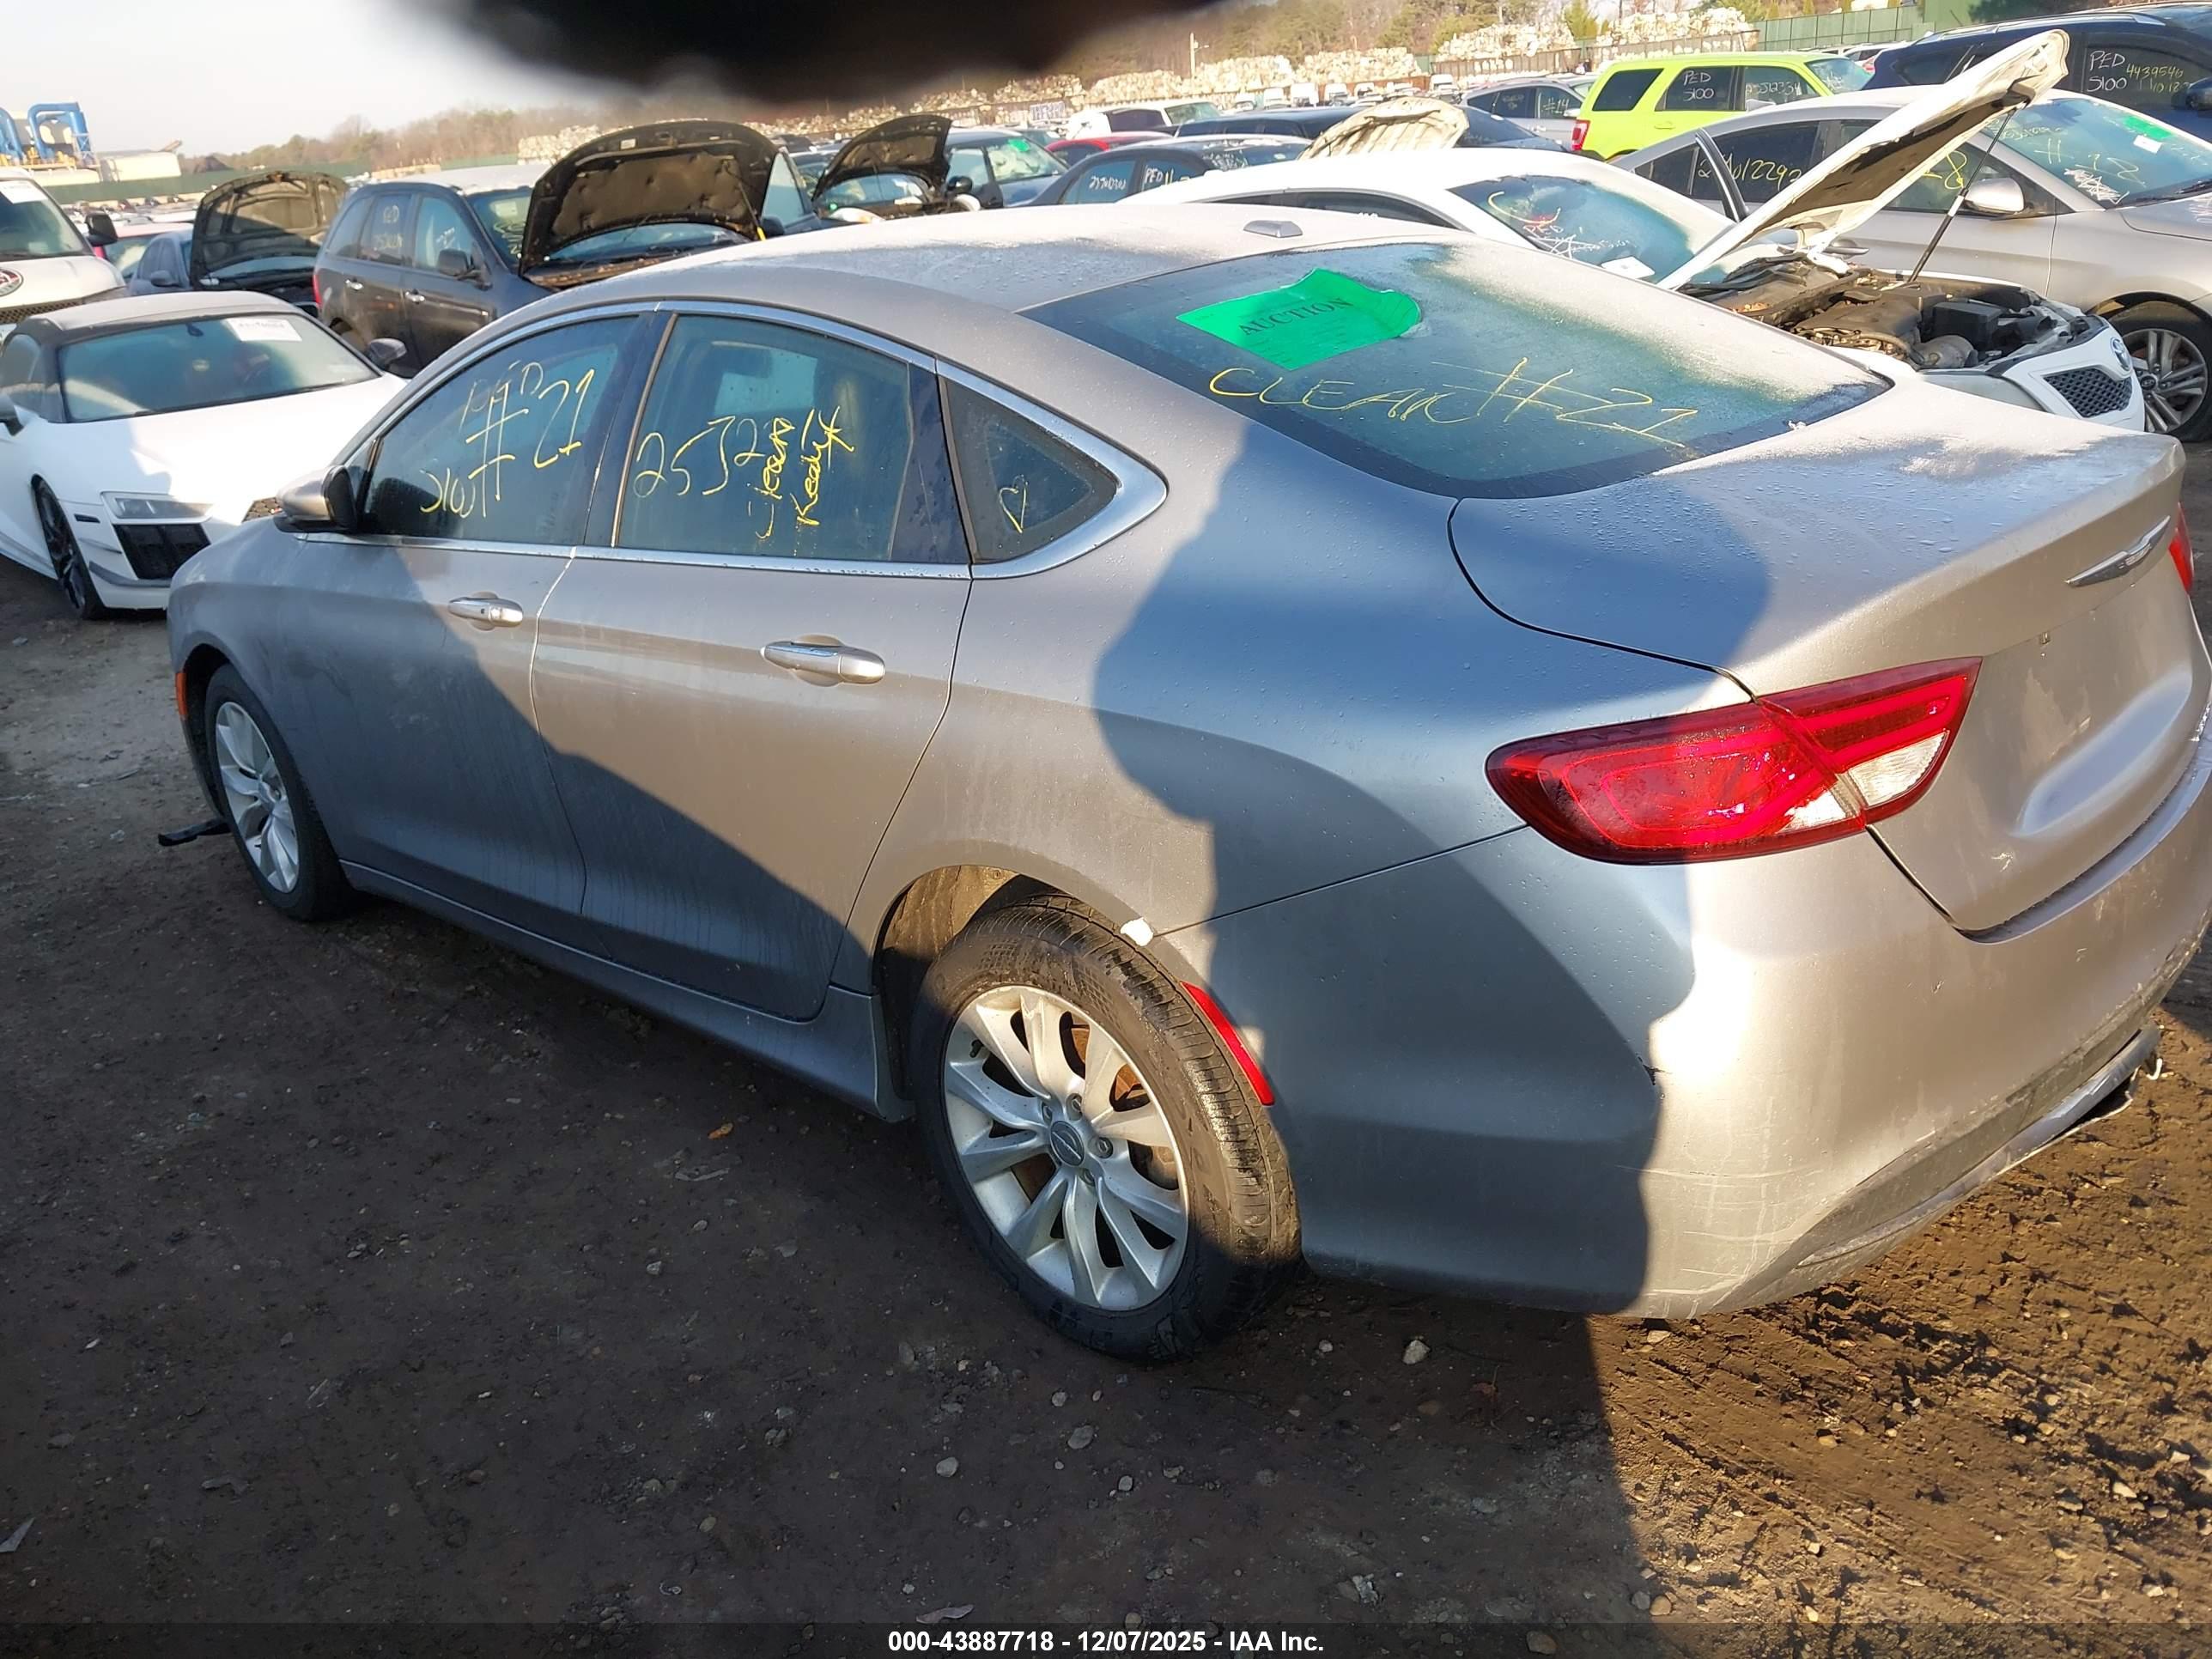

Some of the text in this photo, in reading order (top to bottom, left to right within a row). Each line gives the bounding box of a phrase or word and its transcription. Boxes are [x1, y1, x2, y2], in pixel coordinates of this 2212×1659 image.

[2090, 50, 2125, 70] PED
[1683, 70, 1711, 84] PED
[1237, 296, 1355, 337] AUCTION
